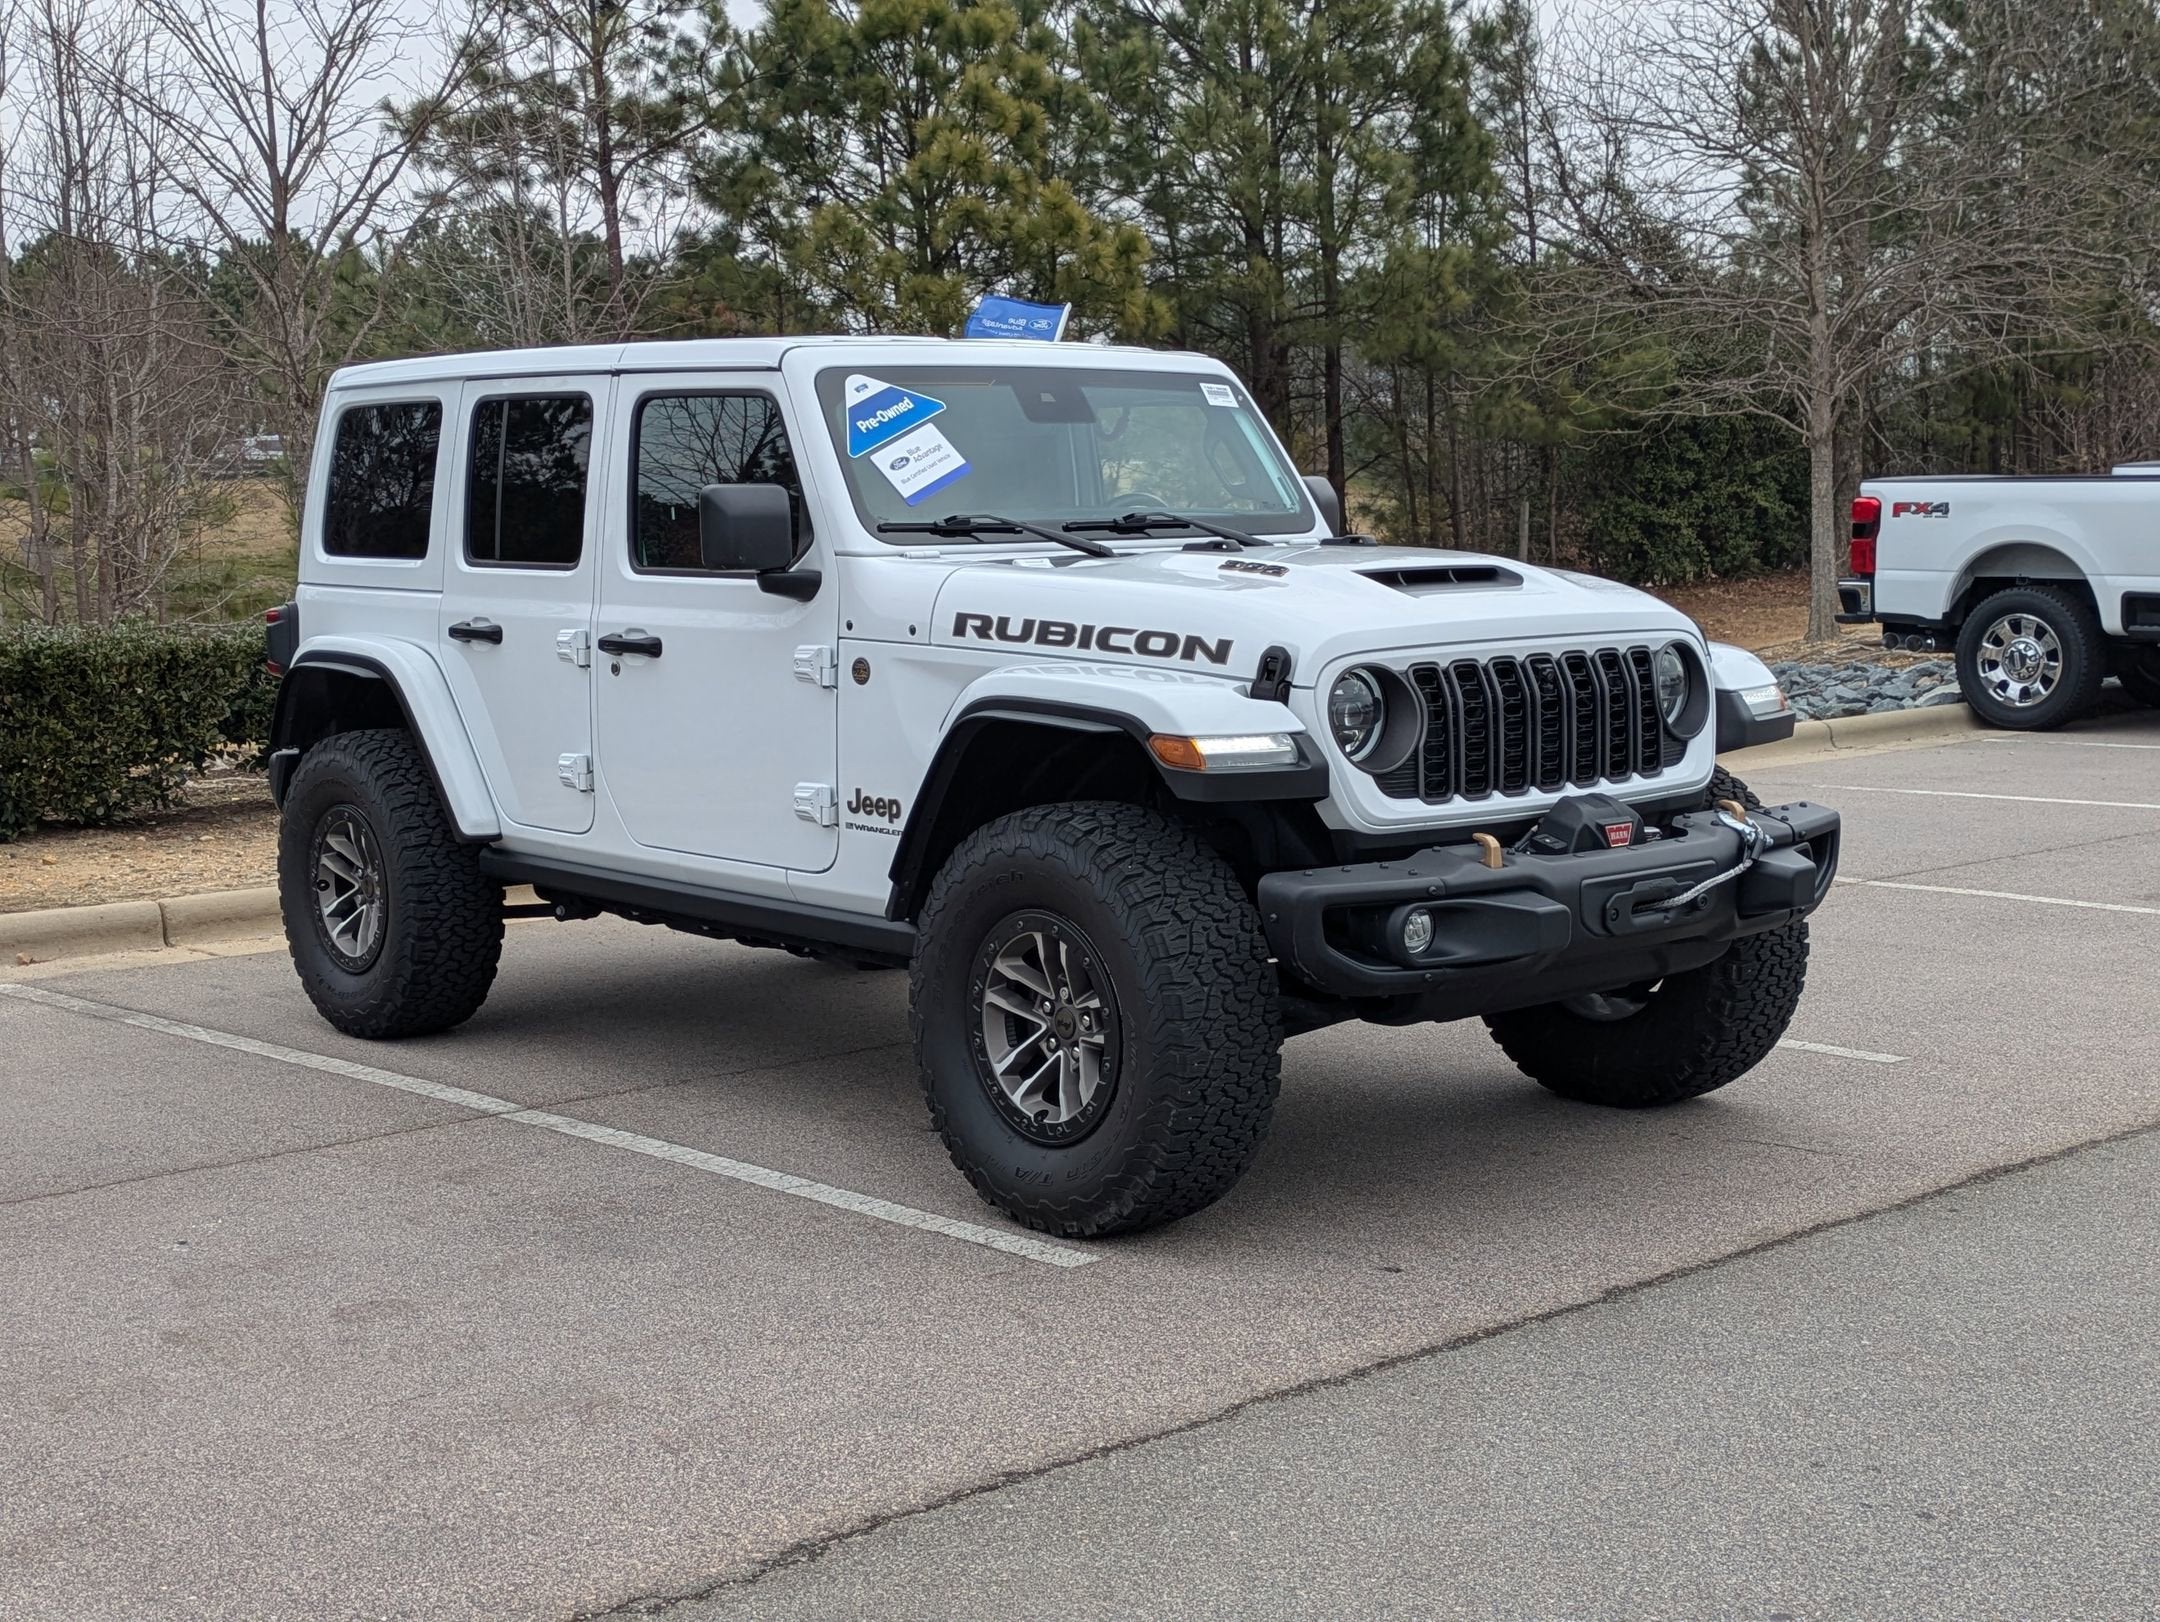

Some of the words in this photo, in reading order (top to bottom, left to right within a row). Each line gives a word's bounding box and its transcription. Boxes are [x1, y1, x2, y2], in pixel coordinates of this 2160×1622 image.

[856, 396, 915, 433] Pre-Owned
[1892, 502, 1950, 518] FX4
[952, 611, 1235, 665] RUBICON
[846, 787, 903, 824] Jeep
